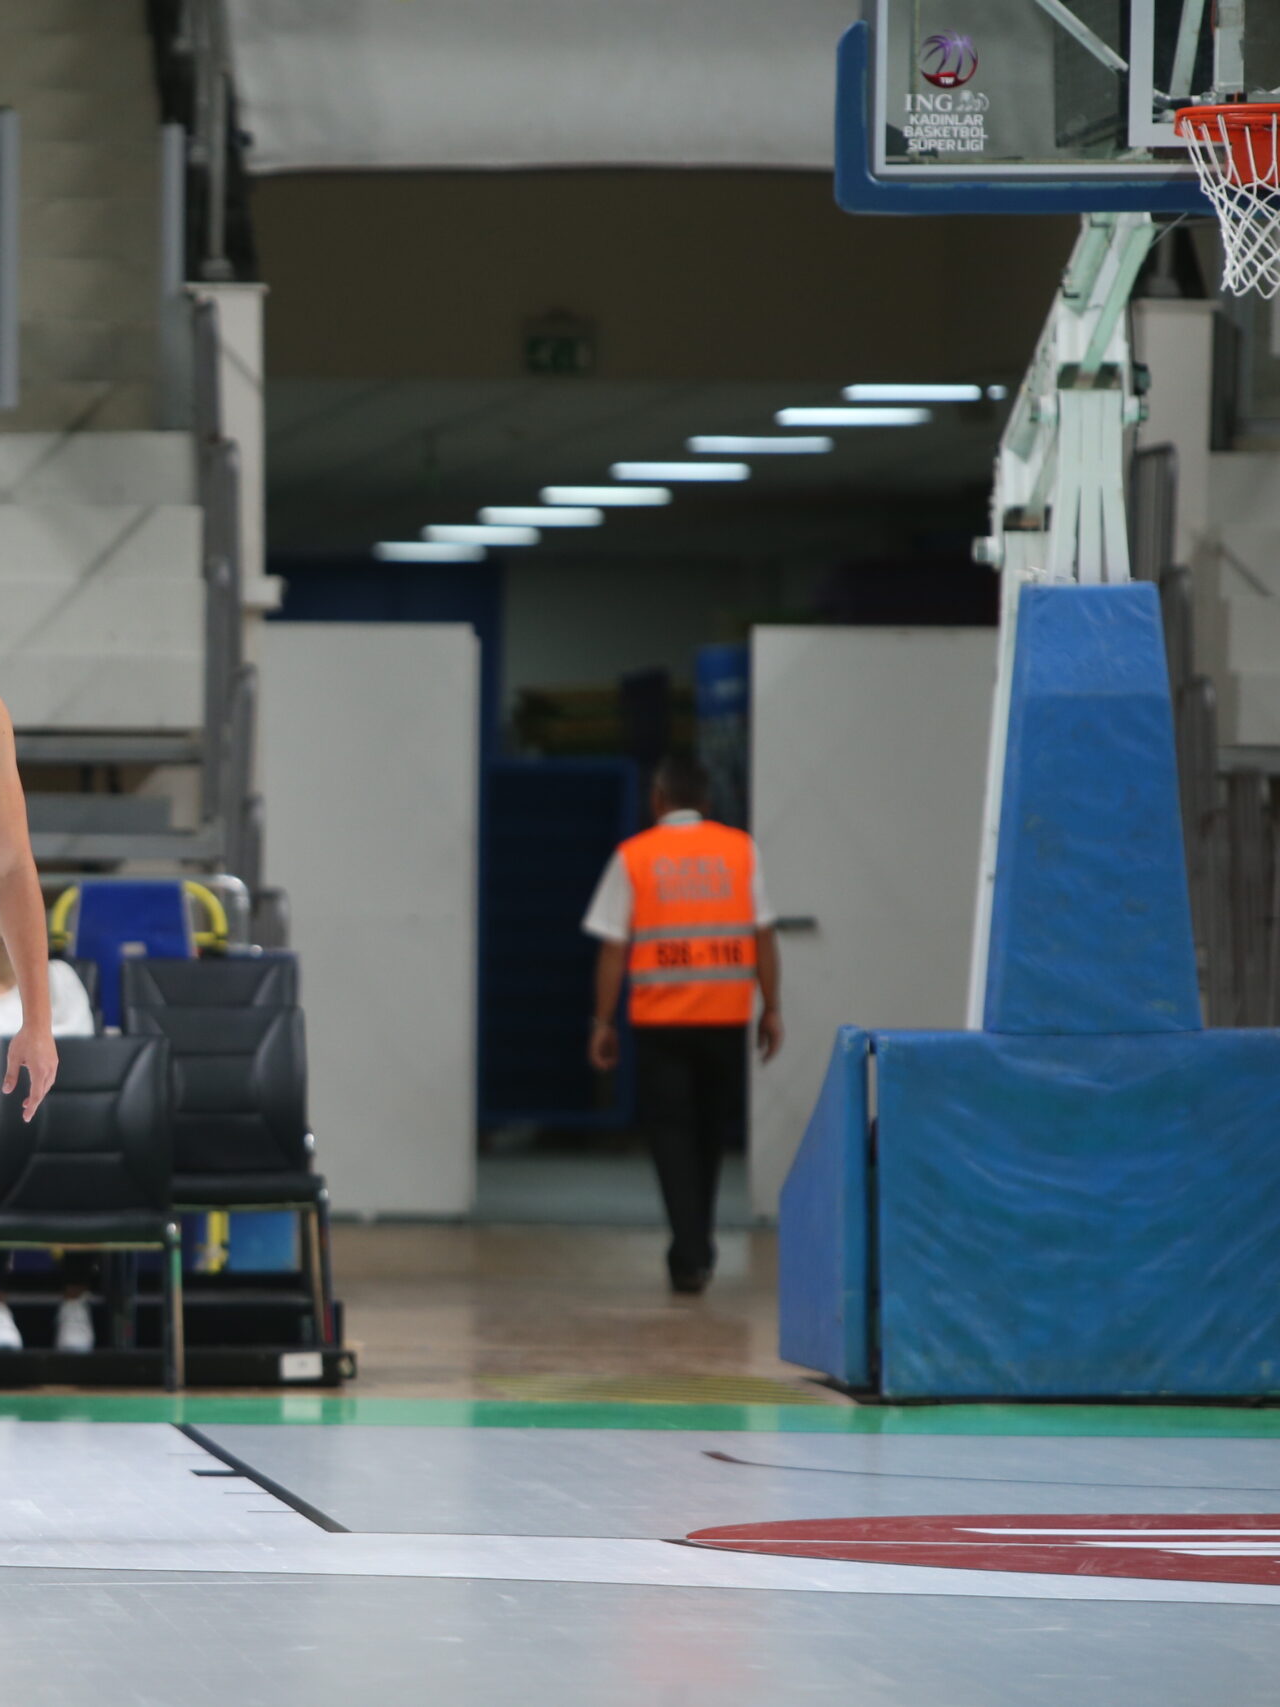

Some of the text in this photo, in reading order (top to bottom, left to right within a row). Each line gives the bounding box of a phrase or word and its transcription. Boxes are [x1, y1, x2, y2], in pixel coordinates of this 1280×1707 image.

[904, 93, 953, 112] ING
[910, 113, 984, 125] KADINLAR
[903, 125, 988, 138] BASKETBOL
